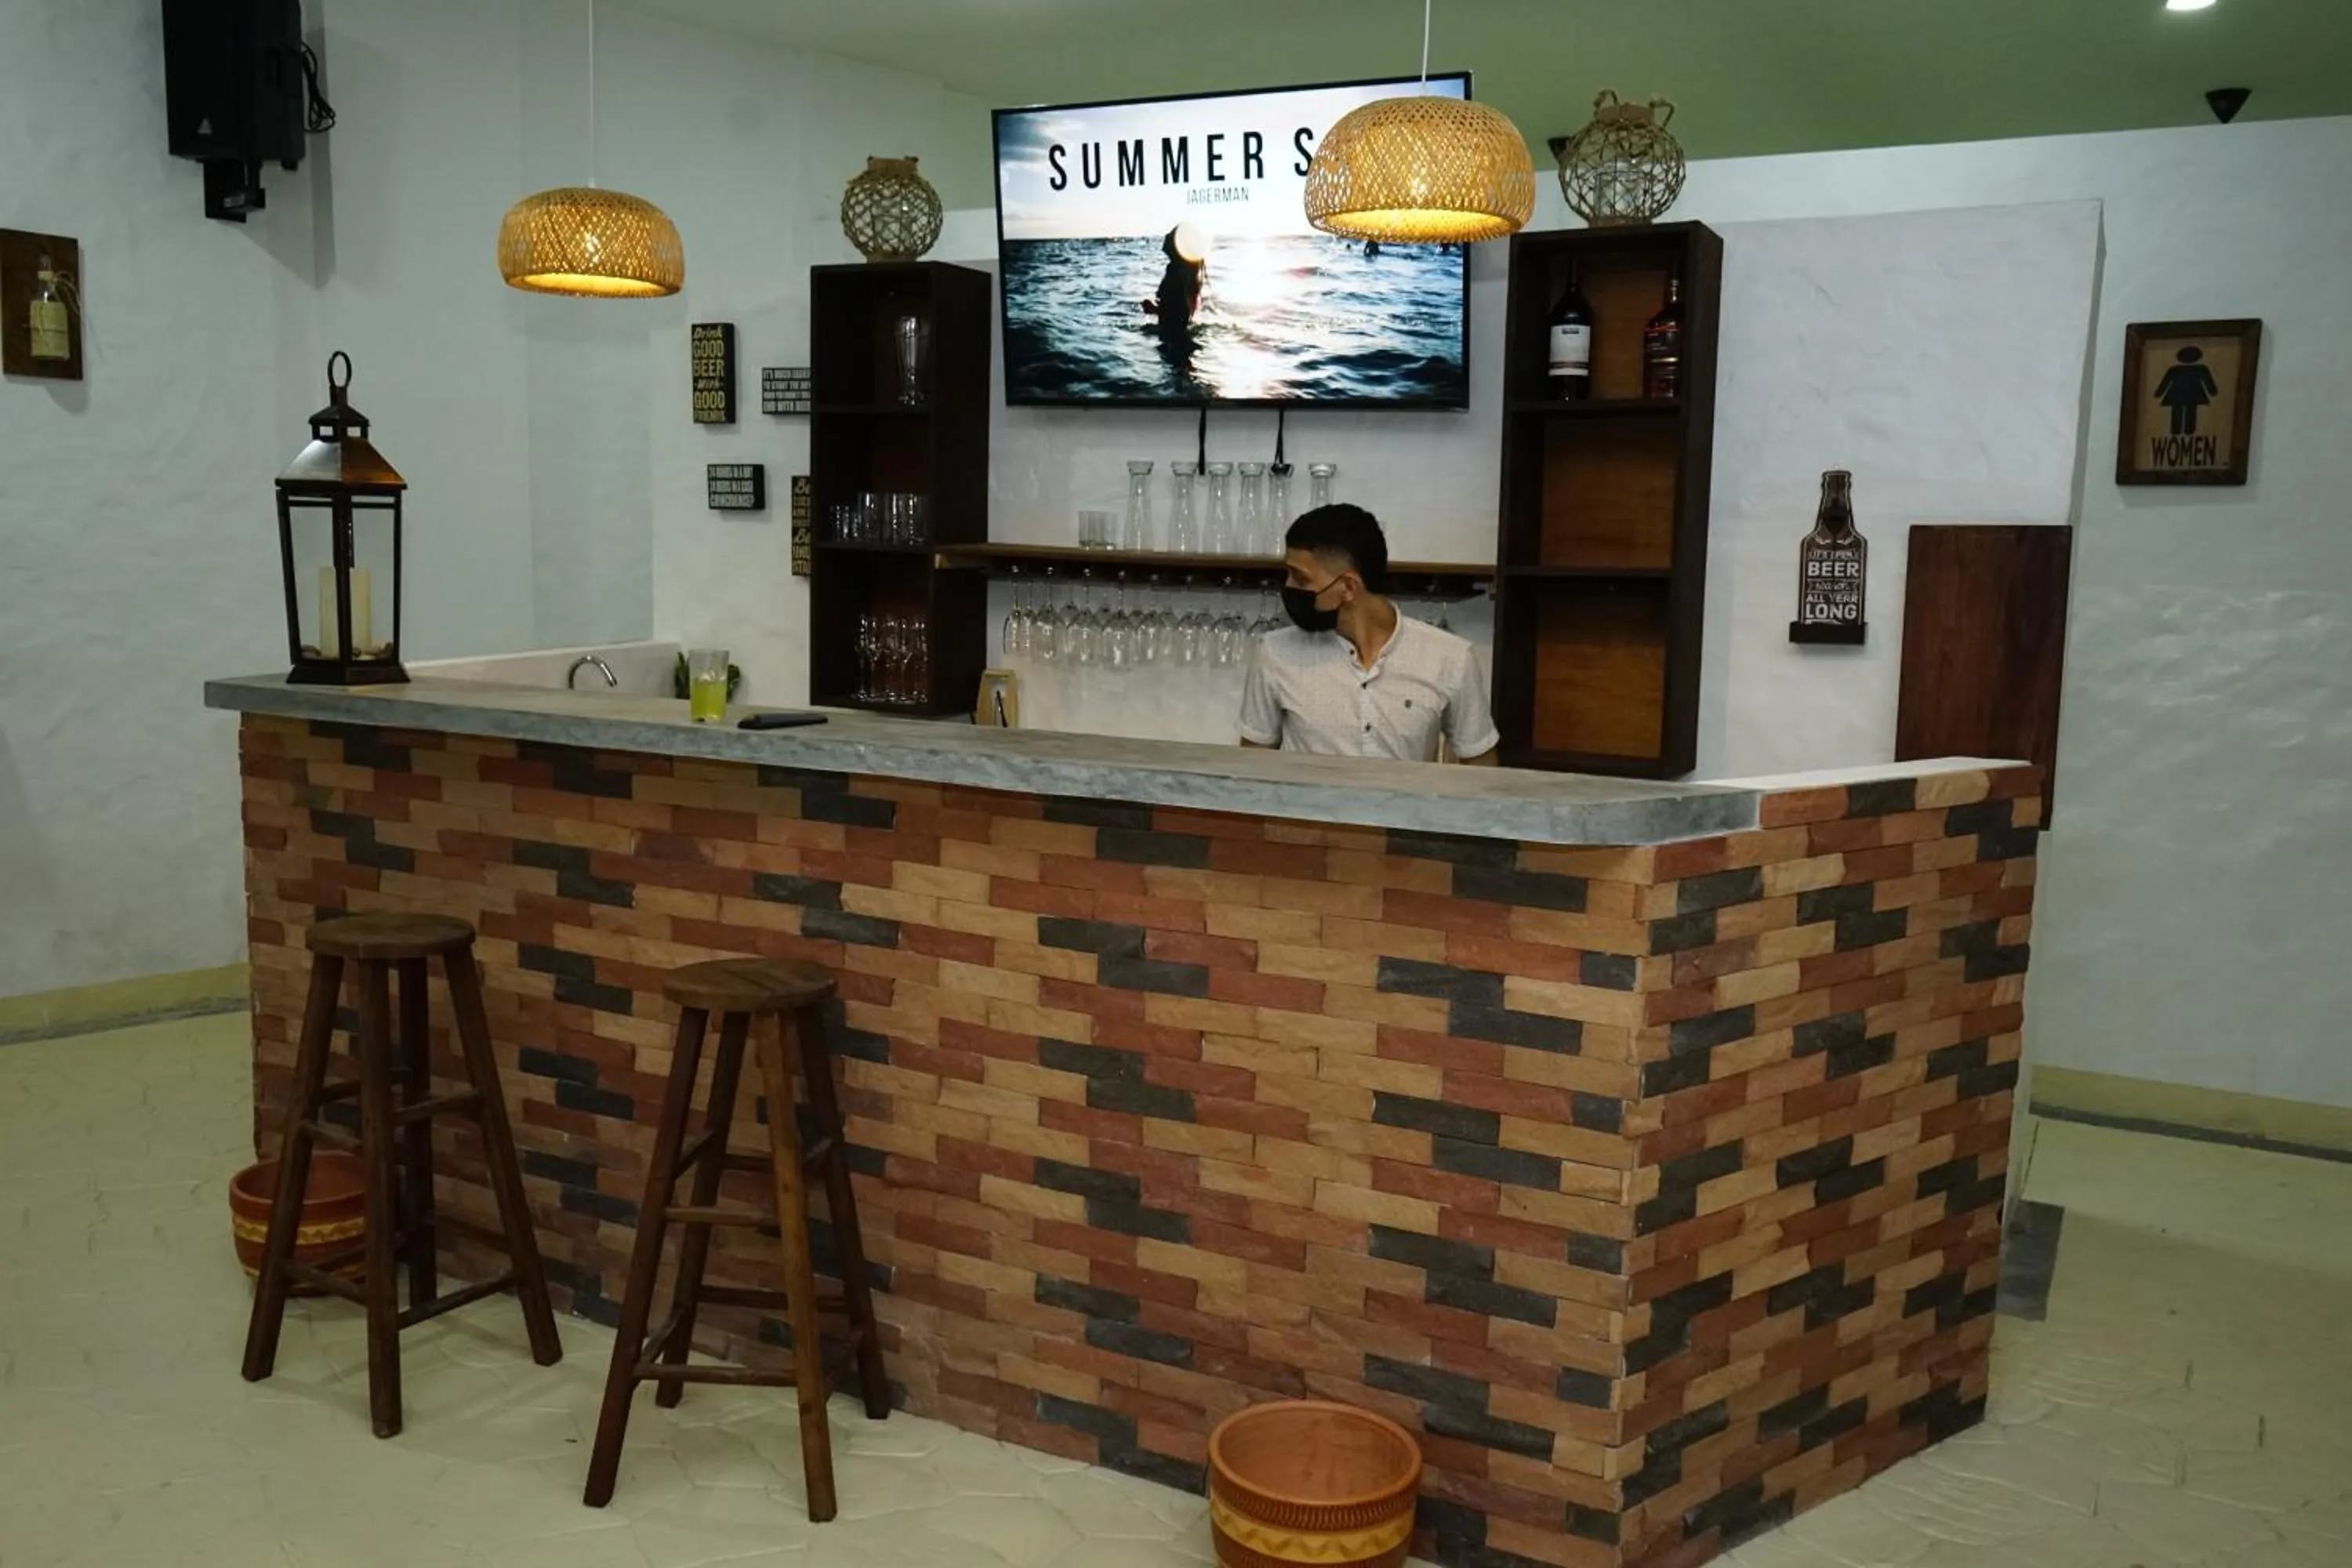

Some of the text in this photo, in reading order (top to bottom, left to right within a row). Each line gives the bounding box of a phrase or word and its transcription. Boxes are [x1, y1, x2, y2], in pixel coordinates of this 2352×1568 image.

[1048, 130, 1264, 191] SUMMER
[693, 339, 724, 358] GOOD
[693, 359, 724, 377] BEER
[694, 390, 725, 408] GOOD
[2151, 435, 2216, 467] WOMEN
[1808, 561, 1859, 577] BEER
[1806, 593, 1825, 603] ALL
[1806, 603, 1857, 619] LONG
